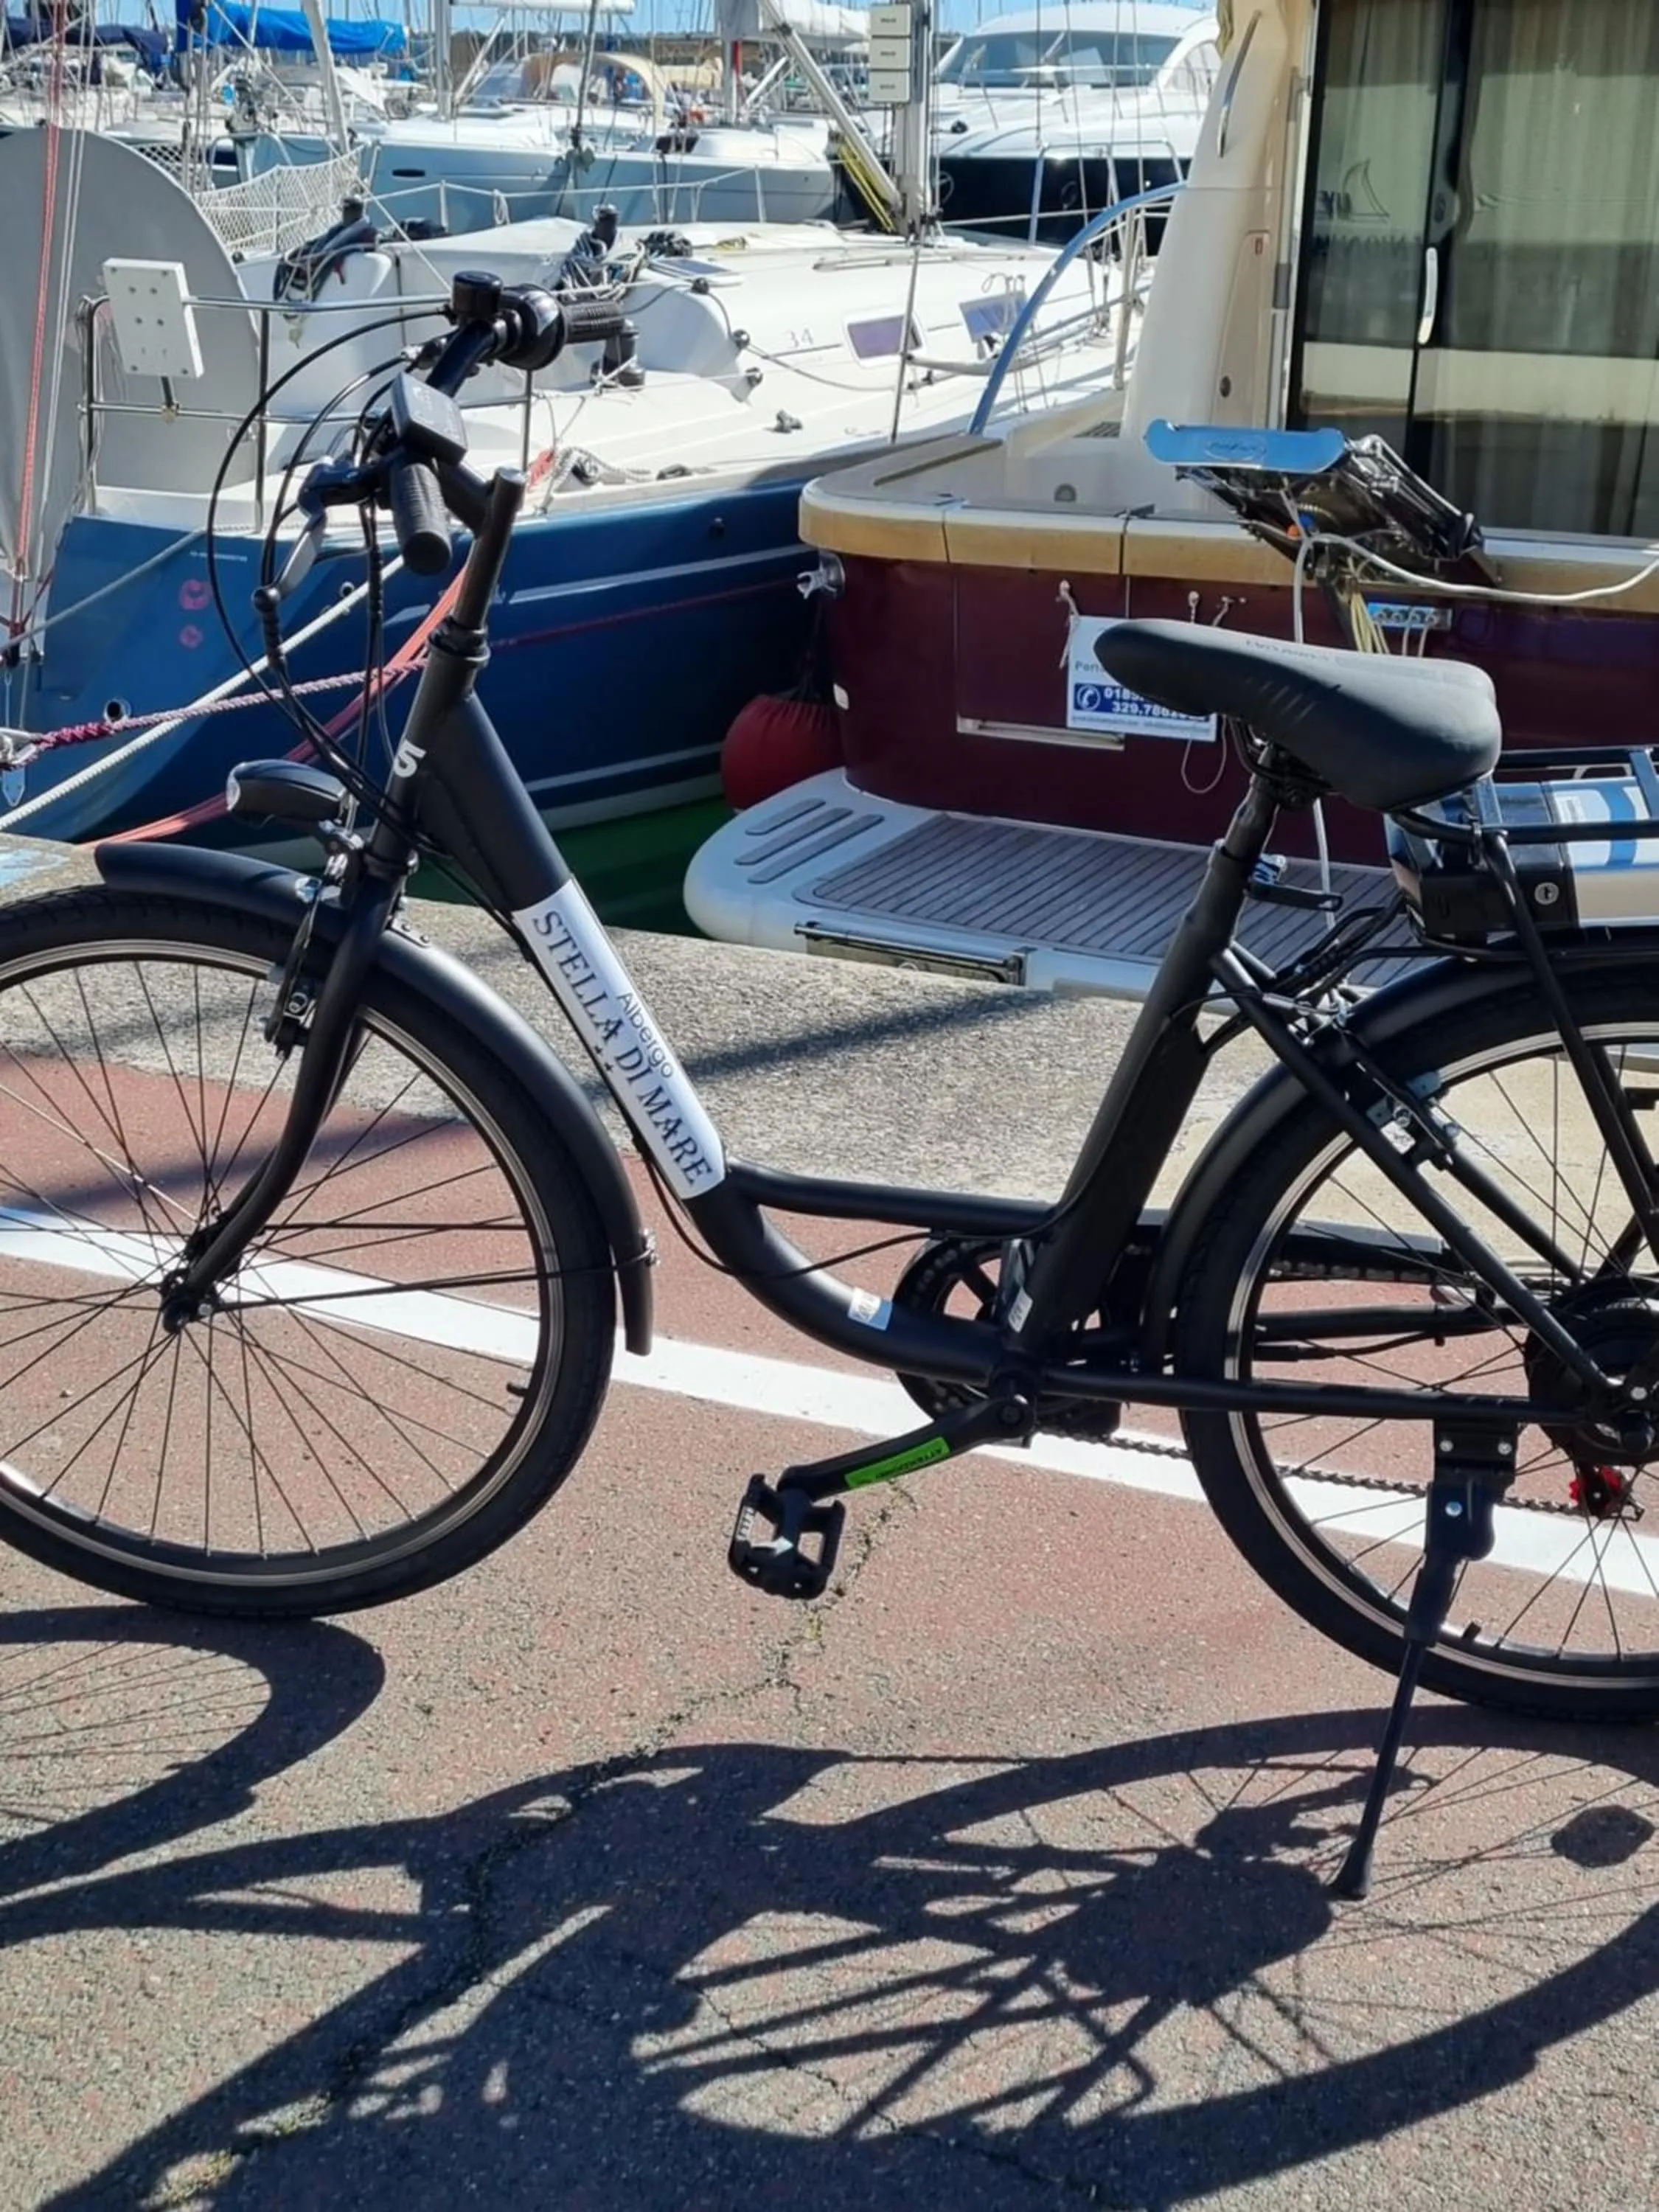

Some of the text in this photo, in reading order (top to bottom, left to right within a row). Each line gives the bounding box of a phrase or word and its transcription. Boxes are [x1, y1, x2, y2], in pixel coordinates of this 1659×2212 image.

[533, 910, 713, 1185] STELLA DI MARE
[616, 991, 674, 1079] Albergo
